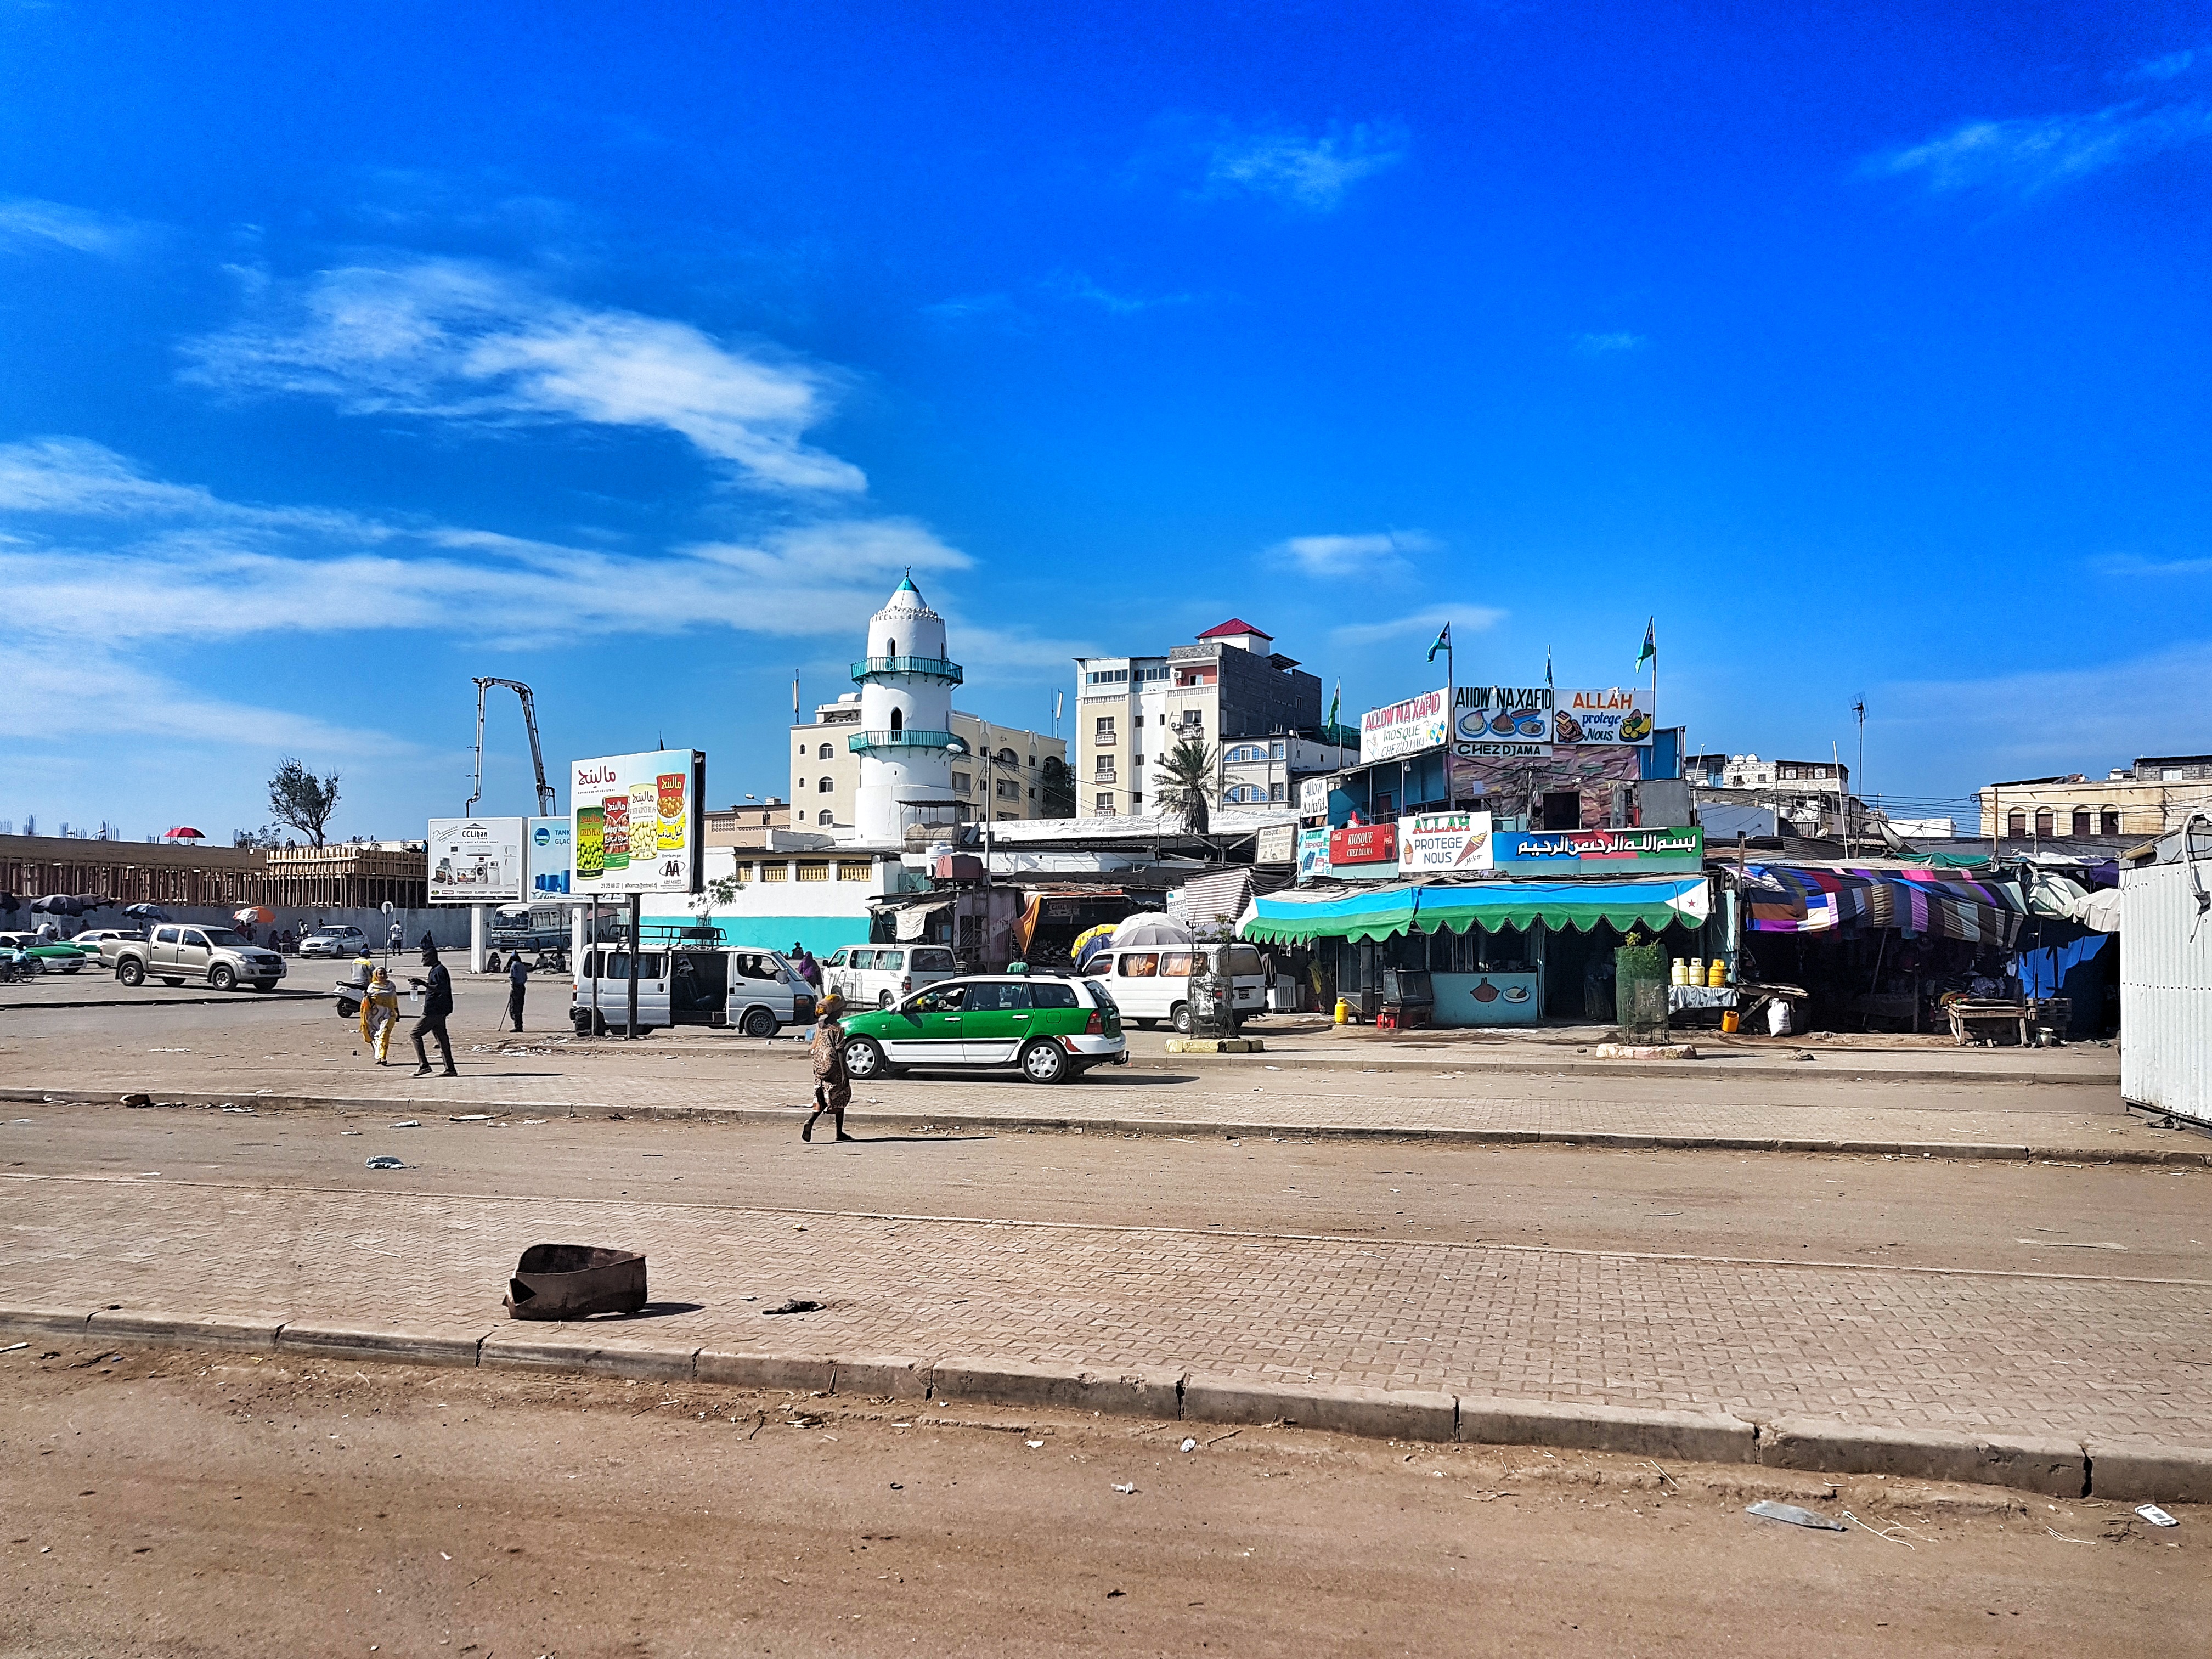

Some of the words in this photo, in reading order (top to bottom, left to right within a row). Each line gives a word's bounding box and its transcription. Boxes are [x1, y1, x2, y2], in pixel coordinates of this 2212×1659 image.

[1497, 688, 1551, 709] NAXAFID
[1572, 692, 1632, 709] ALLAH
[1365, 706, 1394, 733] ALLOW
[1582, 712, 1621, 727] protege
[1584, 728, 1613, 741] Nous
[1381, 742, 1400, 757] CHEZ
[1458, 744, 1500, 755] CHEZ
[1503, 745, 1541, 756] DJAMA
[1412, 816, 1471, 834] ALLAH
[1348, 832, 1373, 846] KIOSQUE
[1415, 837, 1463, 850] PROTEGE
[1517, 834, 1568, 856] الرحيم
[1568, 834, 1624, 855] الرحمن
[1624, 831, 1657, 851] الله
[1657, 834, 1696, 853] بسم
[1347, 849, 1358, 857] CHEZ
[1424, 852, 1452, 864] NOUS
